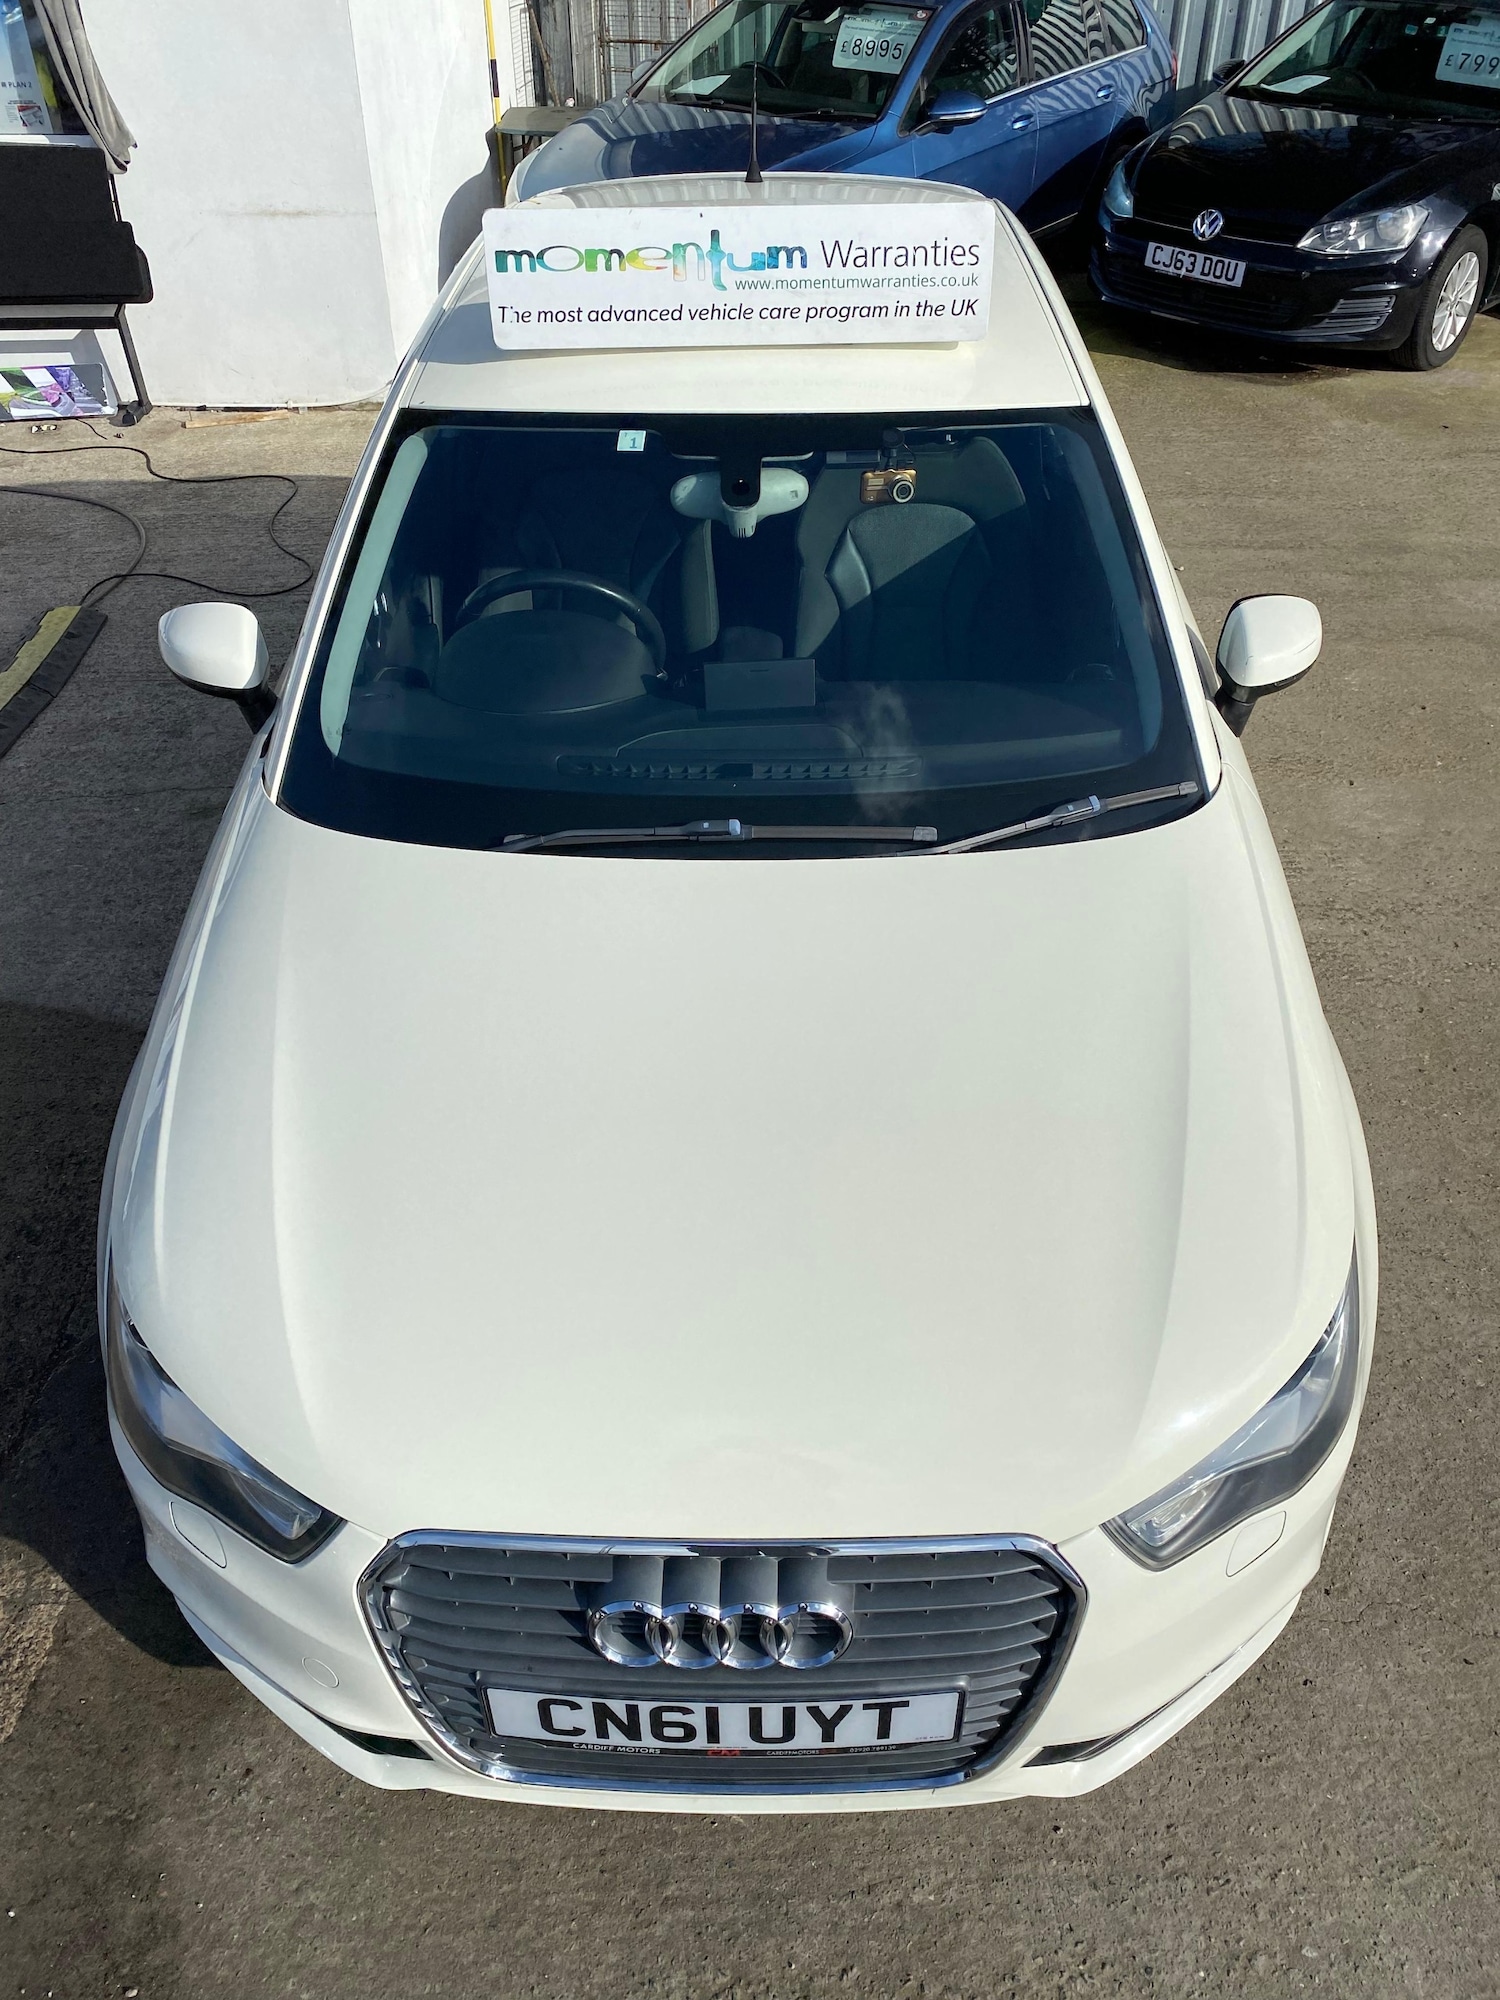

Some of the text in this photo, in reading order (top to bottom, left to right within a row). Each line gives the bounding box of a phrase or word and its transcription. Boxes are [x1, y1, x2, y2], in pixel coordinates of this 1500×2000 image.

[494, 229, 980, 291] momentum Warranties
[1151, 245, 1239, 282] CJ63 DOU
[734, 272, 980, 291] www.momentumwarranties.co.uk
[537, 306, 583, 323] most
[587, 304, 684, 323] advanced
[688, 303, 754, 321] vehicle
[758, 305, 801, 320] care
[805, 303, 889, 323] program
[894, 300, 911, 318] in
[915, 300, 946, 318] the
[950, 298, 980, 316] UK
[629, 437, 638, 449] 1
[536, 1697, 910, 1745] CN61 UYT
[572, 1743, 662, 1755] CARDIFF MOTORS
